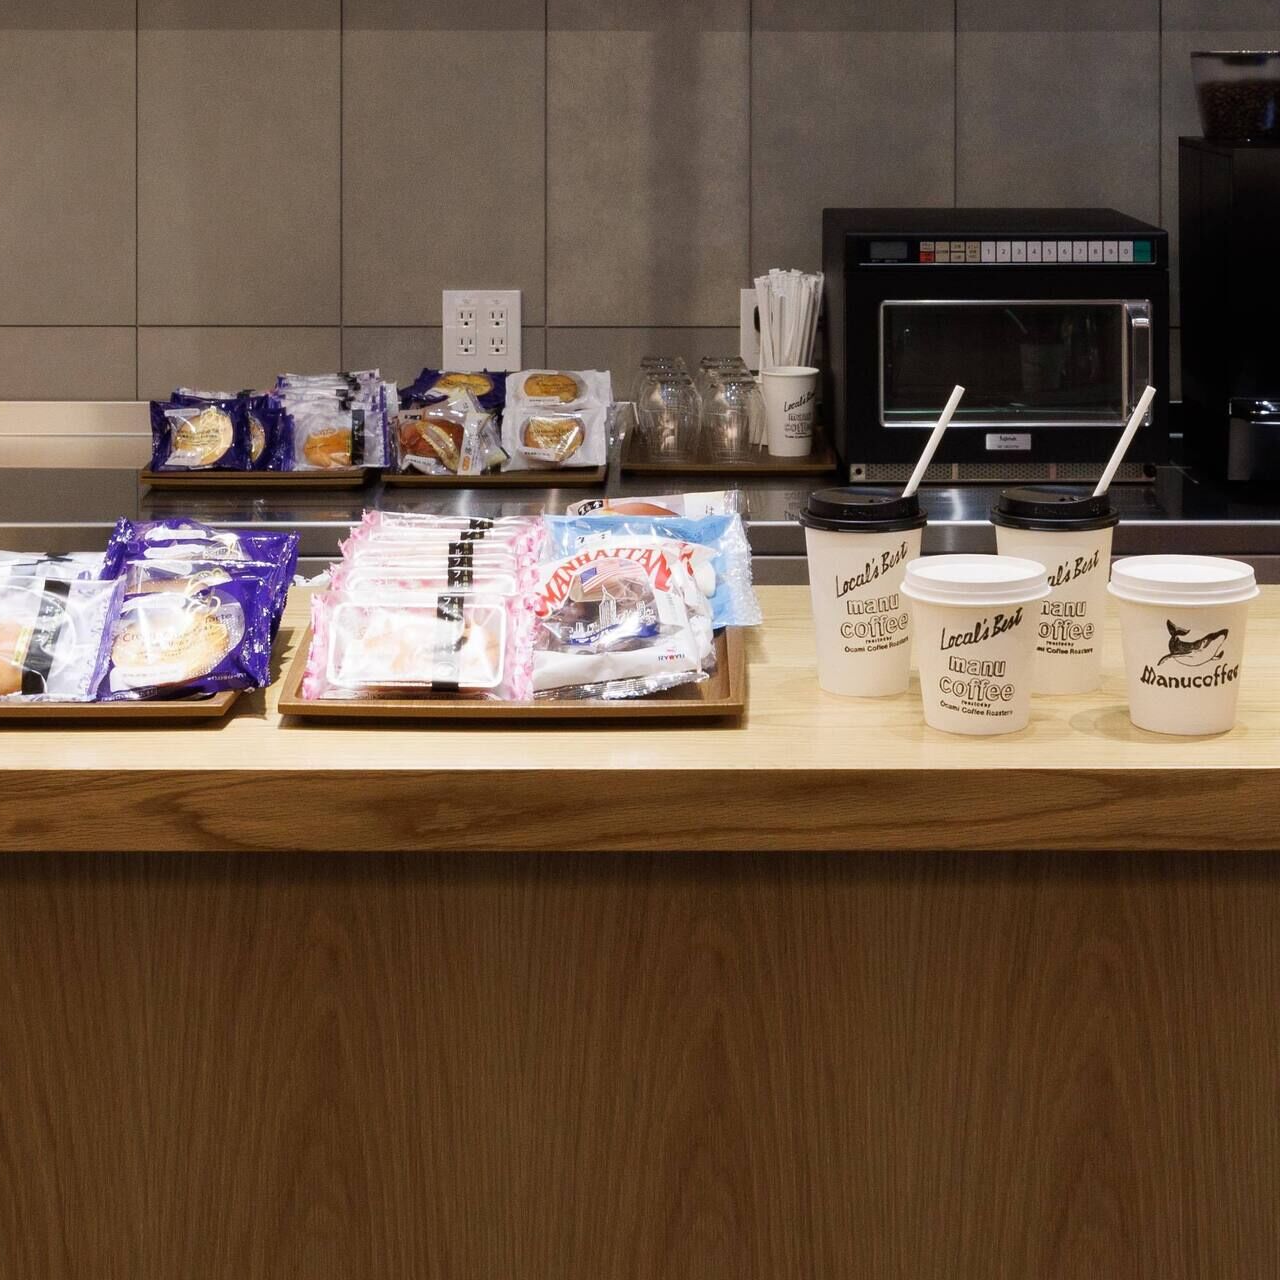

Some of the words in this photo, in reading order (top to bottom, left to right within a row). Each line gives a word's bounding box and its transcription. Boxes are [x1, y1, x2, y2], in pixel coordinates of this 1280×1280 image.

[835, 558, 879, 598] Local's
[881, 541, 908, 575] Best
[1047, 561, 1071, 587] al's
[1073, 549, 1099, 579] Best
[535, 547, 672, 617] MANHATTAN
[847, 593, 900, 615] manu
[840, 612, 909, 638] coffee
[940, 618, 990, 651] Local's
[991, 606, 1024, 638] Best
[1038, 618, 1095, 641] offee
[867, 642, 888, 652] Coffee
[1046, 647, 1068, 655] Coffee
[949, 655, 1006, 678] manu
[939, 675, 1016, 702] coffee
[961, 706, 985, 716] Coffee
